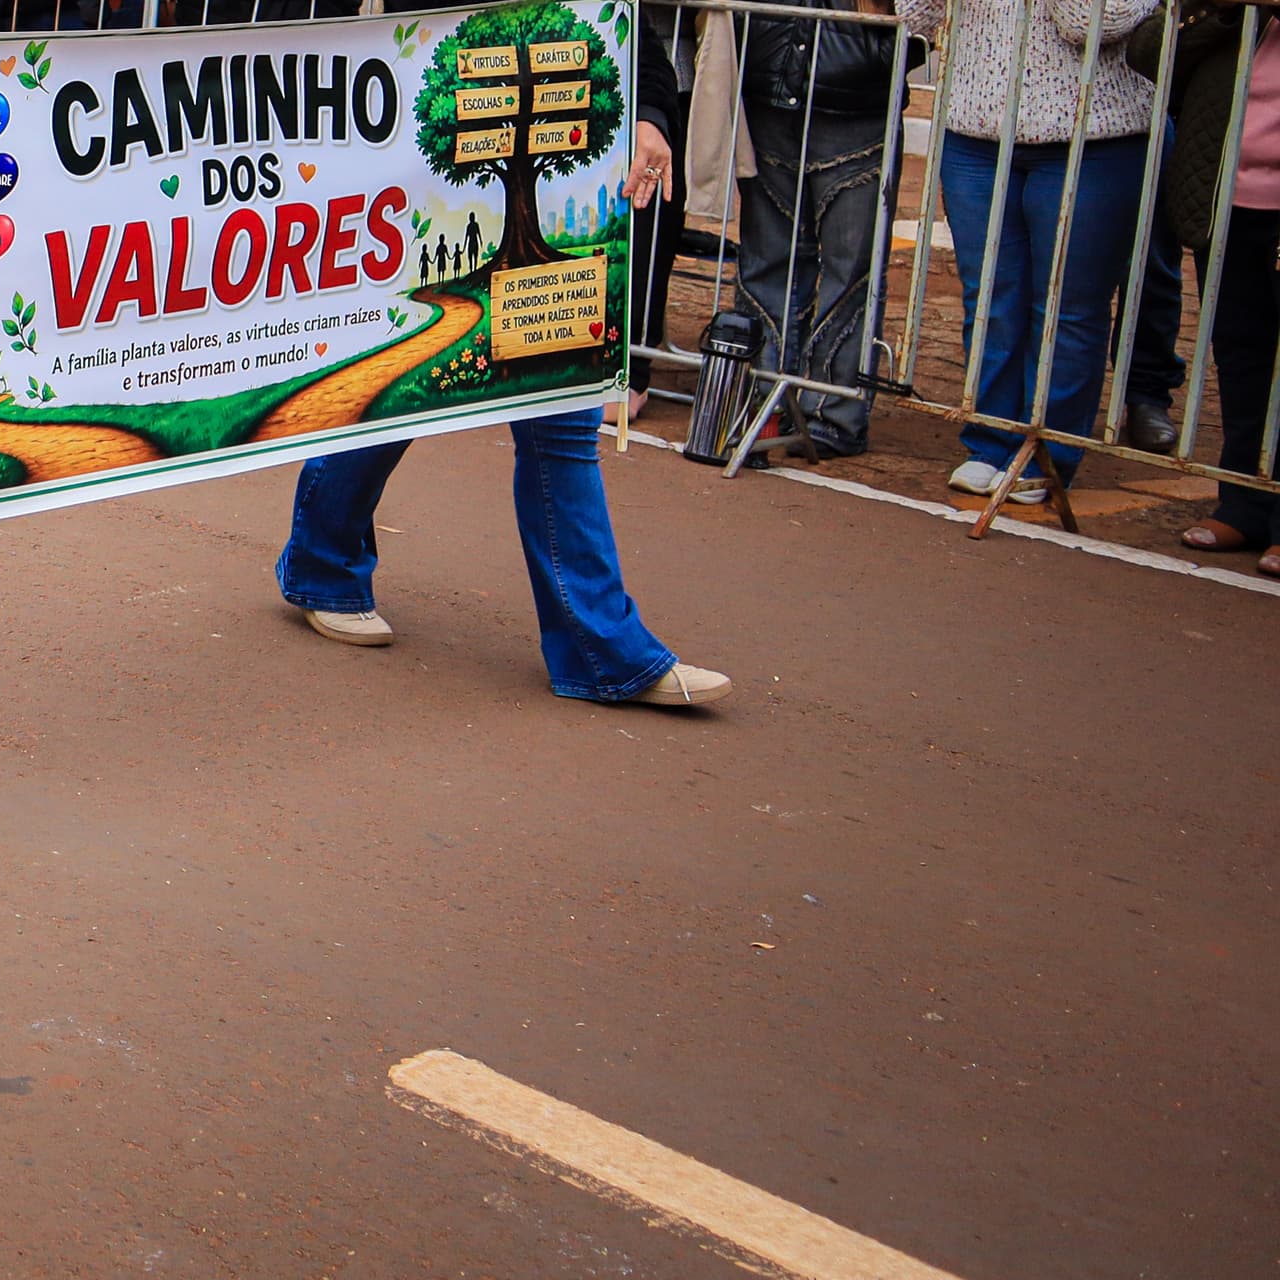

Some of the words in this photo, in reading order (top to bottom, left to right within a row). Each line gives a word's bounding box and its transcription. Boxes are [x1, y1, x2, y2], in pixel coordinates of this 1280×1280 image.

[472, 56, 511, 69] VIRTUDES
[536, 48, 571, 65] CARÁTER
[463, 96, 503, 111] ESCOLHAS
[540, 90, 573, 104] ATITUDES
[51, 54, 398, 176] CAMINHO
[461, 136, 497, 154] RELAÇÕES
[535, 131, 564, 145] FRUTOS
[201, 153, 281, 206] DOS
[44, 185, 408, 330] VALORES
[504, 281, 515, 293] OS
[518, 274, 559, 291] PRIMEIROS
[561, 269, 596, 284] VALORES
[502, 294, 550, 312] APRENDIDOS
[552, 292, 564, 303] EM
[566, 285, 598, 301] FAMÍLIA
[502, 318, 511, 330] SE
[514, 314, 546, 328] TORNAM
[548, 307, 575, 322] RAÍZES
[578, 305, 599, 318] PARA
[52, 357, 63, 375] A
[68, 348, 117, 374] família
[121, 340, 165, 367] planta
[170, 334, 223, 355] valores,
[226, 331, 241, 344] as
[246, 318, 300, 342] virtudes
[303, 316, 341, 332] criam
[345, 308, 381, 326] raízes
[524, 332, 544, 344] TODA
[546, 330, 552, 340] A
[122, 376, 132, 391] e
[137, 360, 235, 389] transformam
[241, 356, 251, 370] o
[255, 343, 309, 369] mundo!
